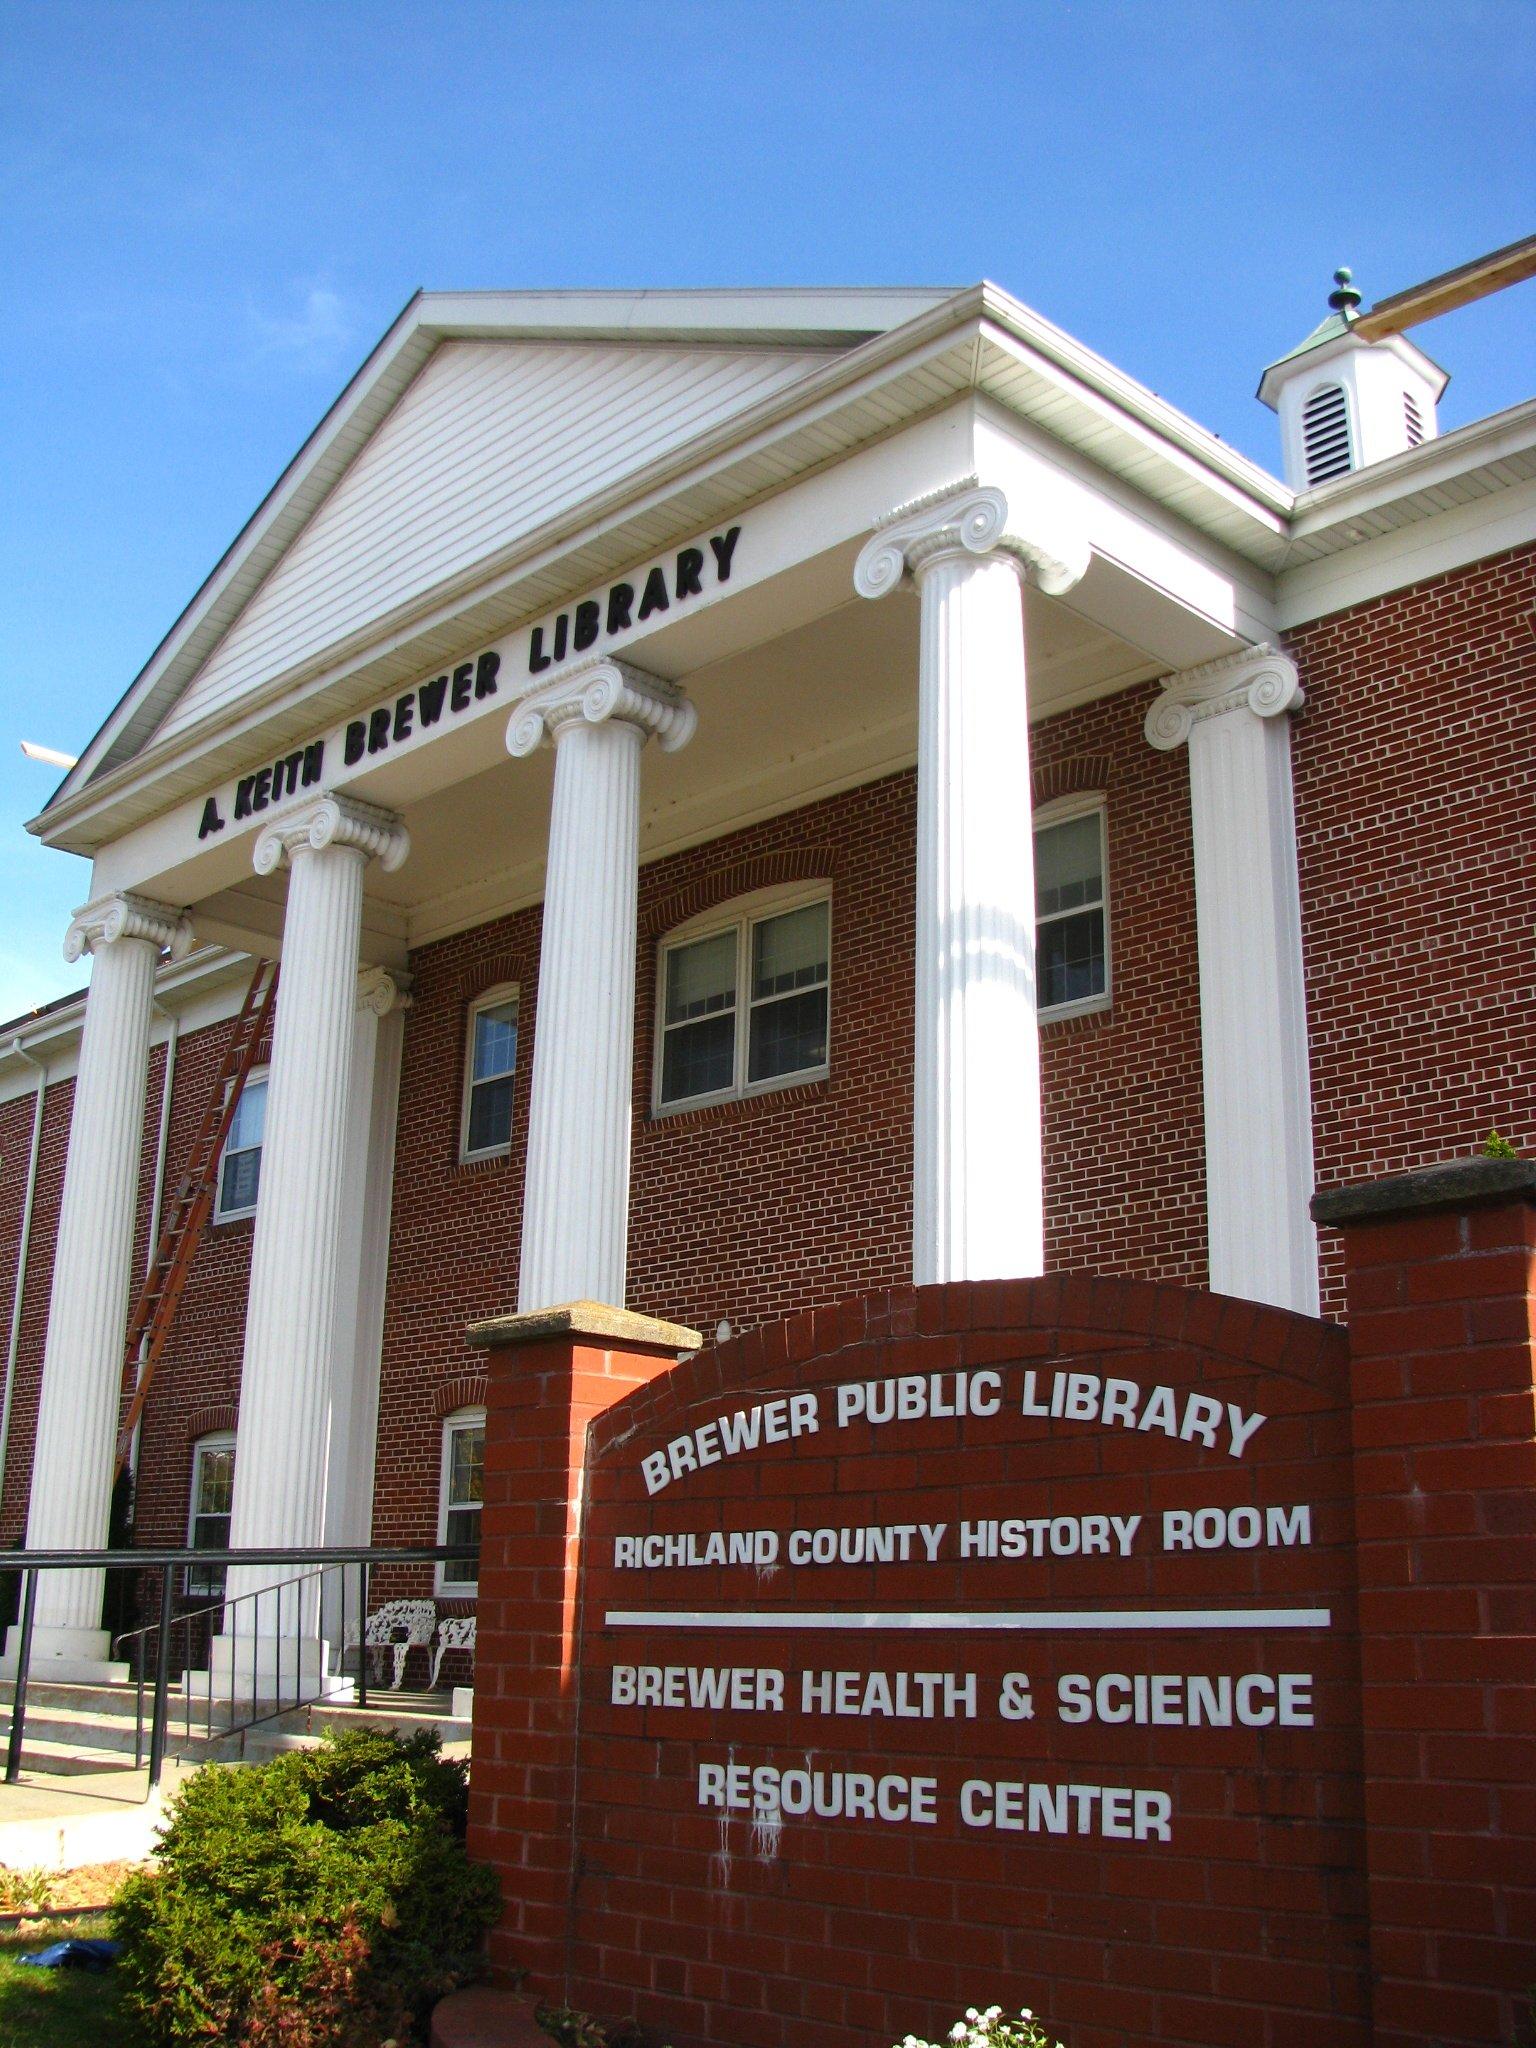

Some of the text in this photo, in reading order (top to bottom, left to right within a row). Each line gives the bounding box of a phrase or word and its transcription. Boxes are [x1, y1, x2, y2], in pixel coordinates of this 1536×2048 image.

[198, 526, 741, 840] A. KEITH BREWER LIBRARY
[640, 1371, 1267, 1496] BREWER PUBLIC LIBRARY
[614, 1505, 1311, 1568] RICHLAND COUNTY HISTORY ROOM
[611, 1665, 1314, 1727] BREWER HEALTH & SCIENCE
[698, 1763, 1172, 1841] RESOURCE CENTER
